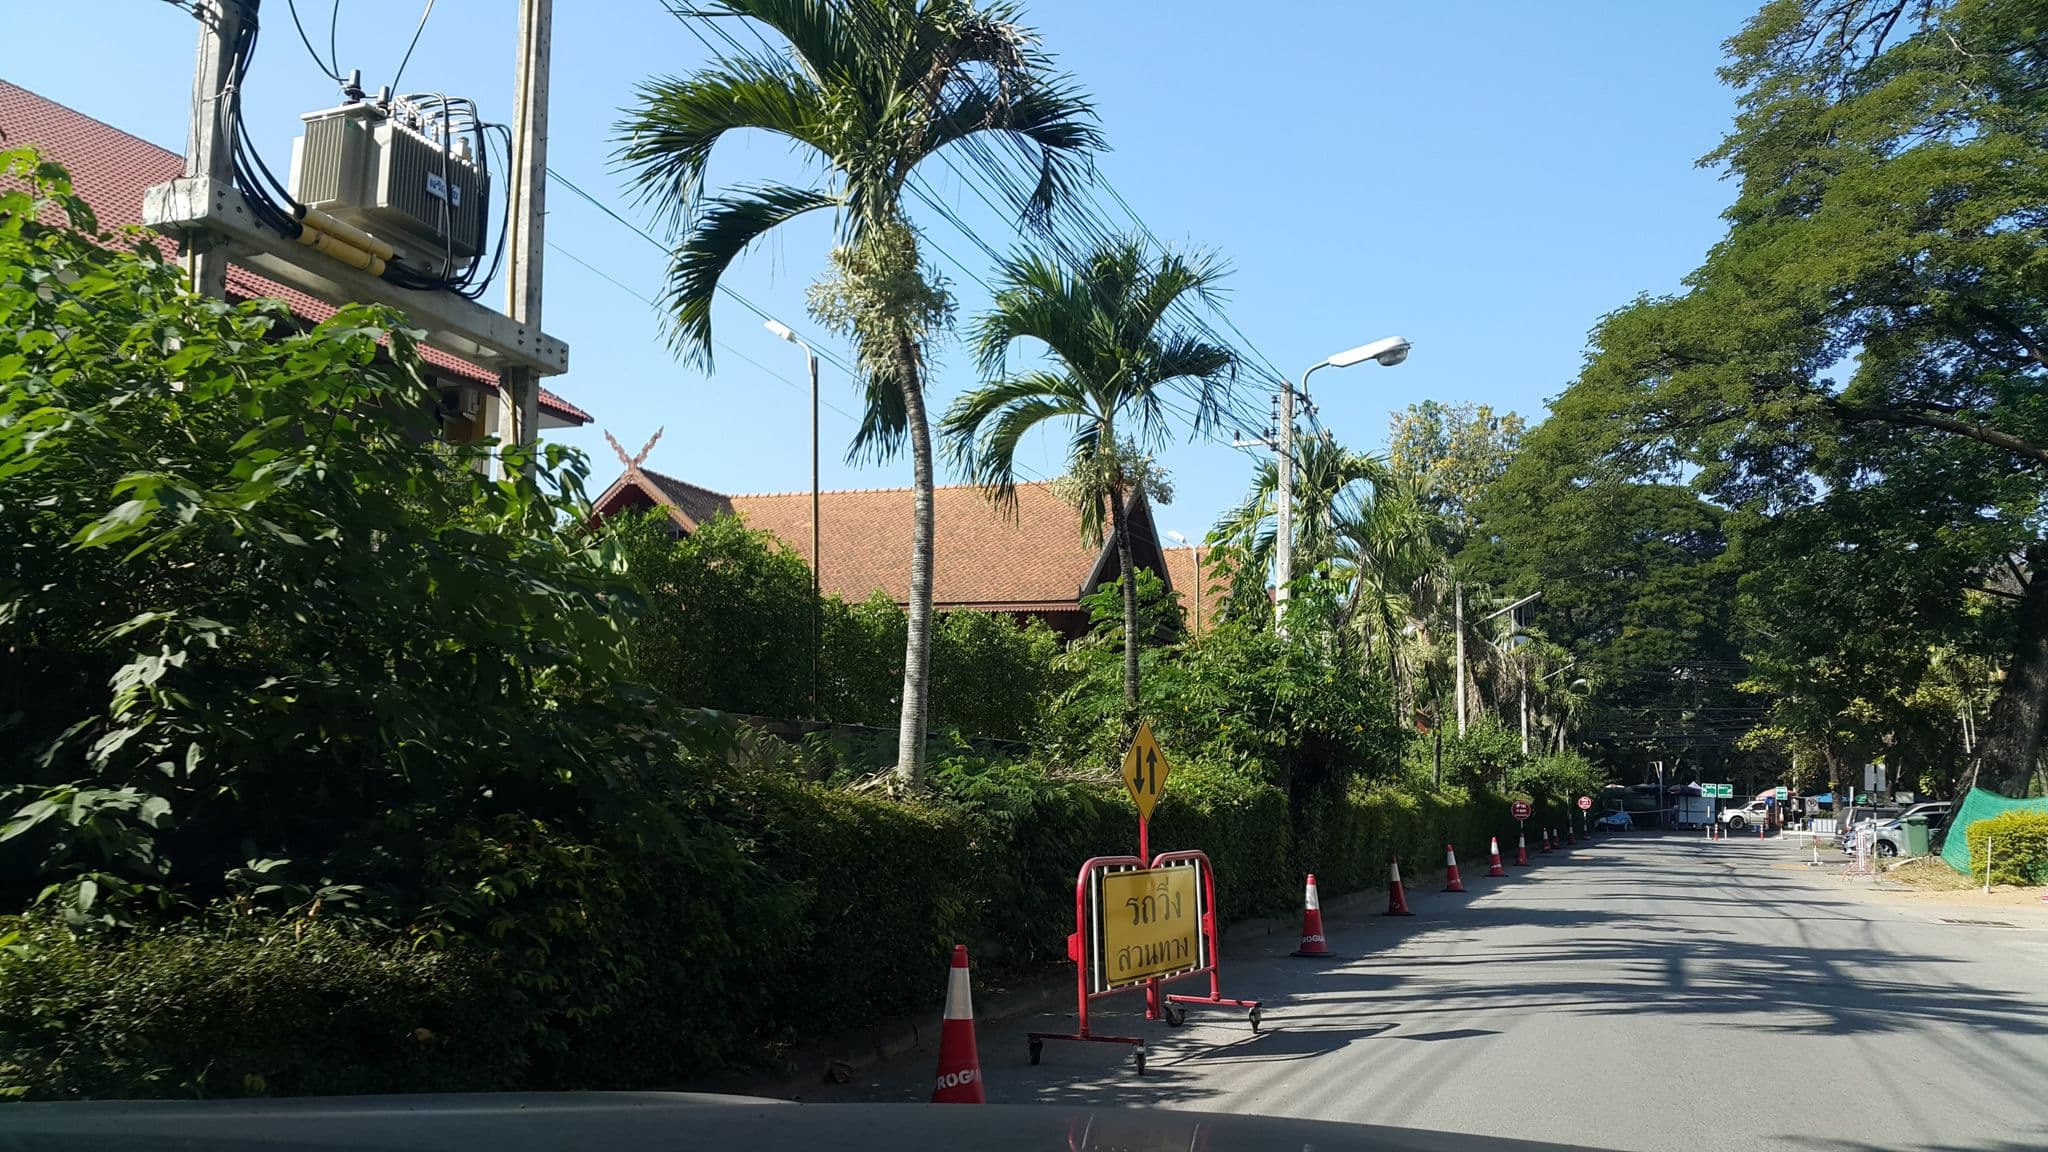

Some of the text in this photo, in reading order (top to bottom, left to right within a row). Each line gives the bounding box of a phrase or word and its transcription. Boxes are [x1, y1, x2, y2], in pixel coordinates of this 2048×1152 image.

[1125, 877, 1182, 926] รถวิ่ง
[1119, 937, 1189, 972] สวนทาง
